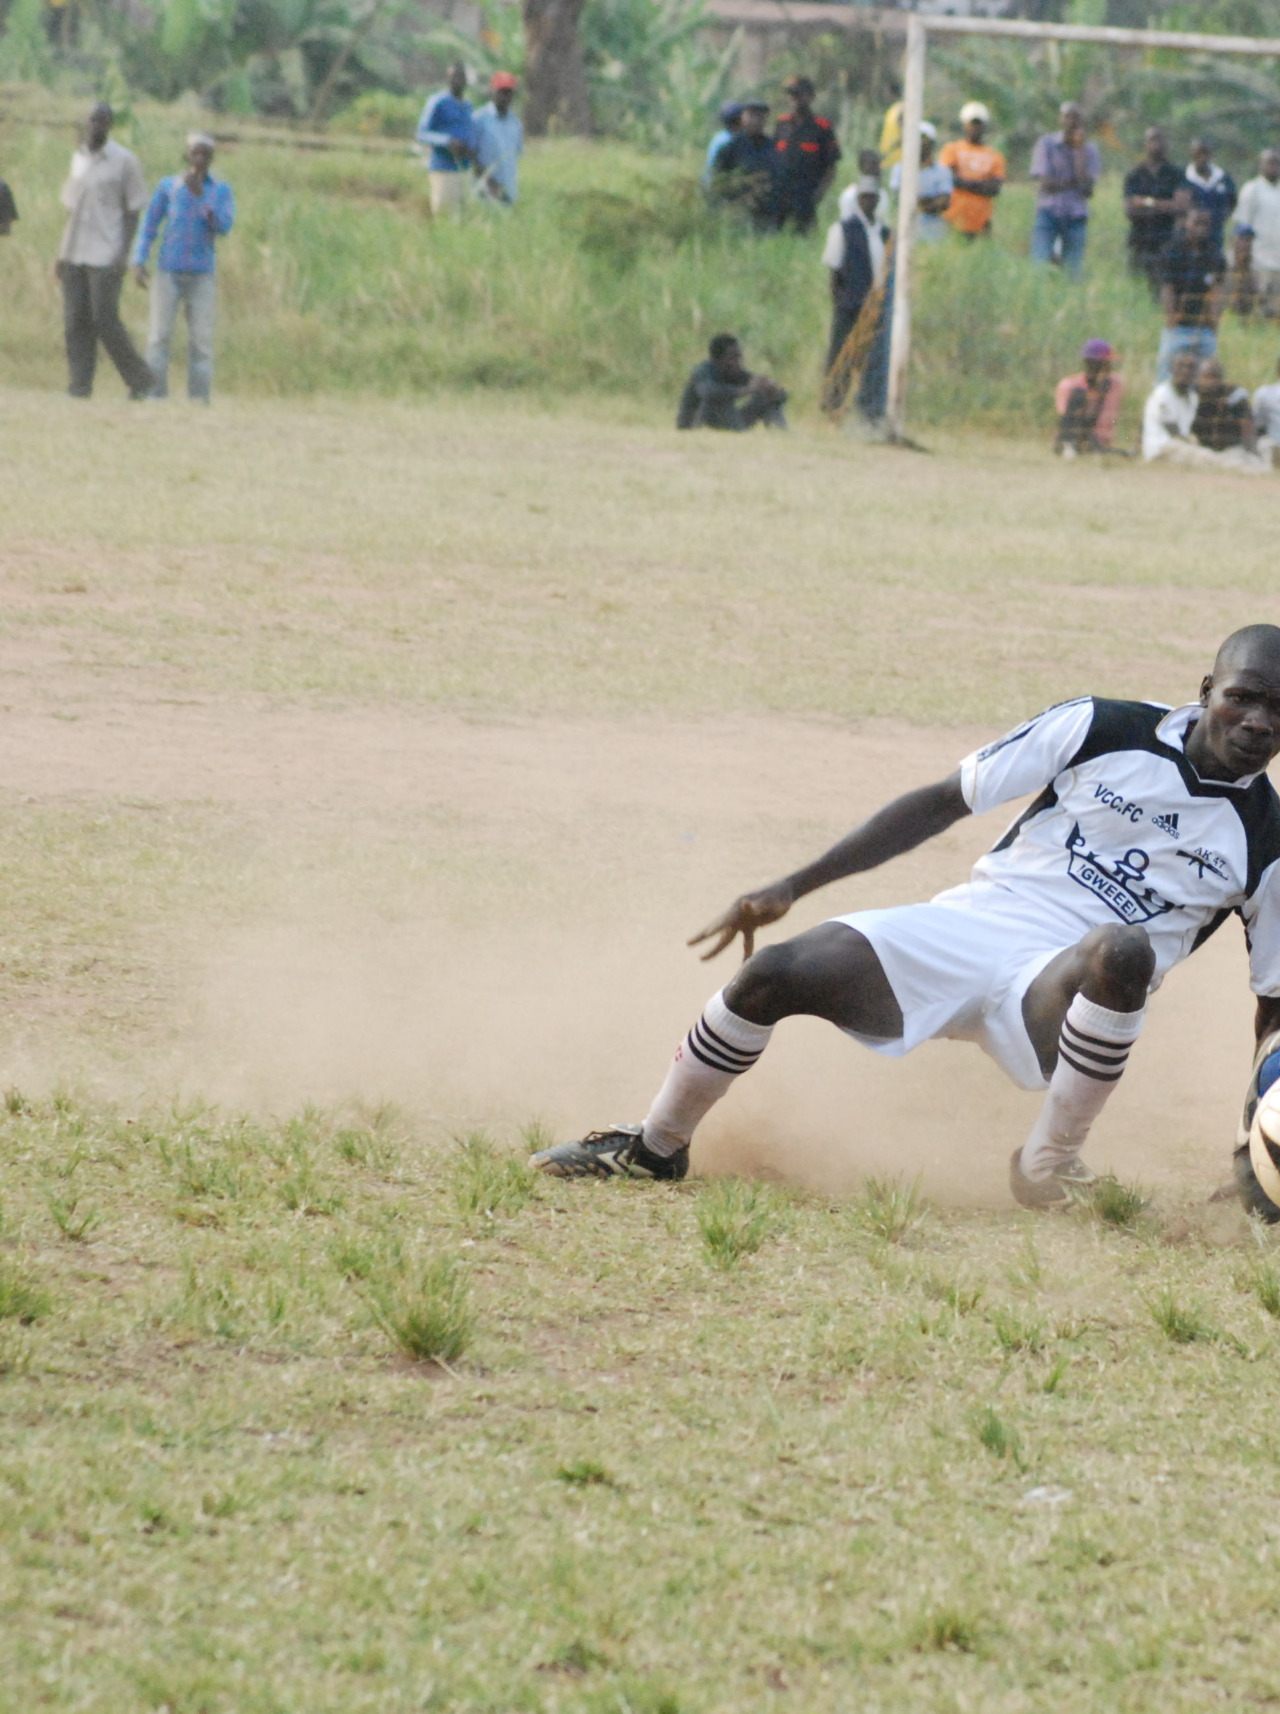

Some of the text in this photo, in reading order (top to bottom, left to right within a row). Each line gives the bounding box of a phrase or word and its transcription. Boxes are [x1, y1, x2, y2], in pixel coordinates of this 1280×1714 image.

[1094, 783, 1144, 823] VCC.FC
[1194, 847, 1226, 869] AK 47
